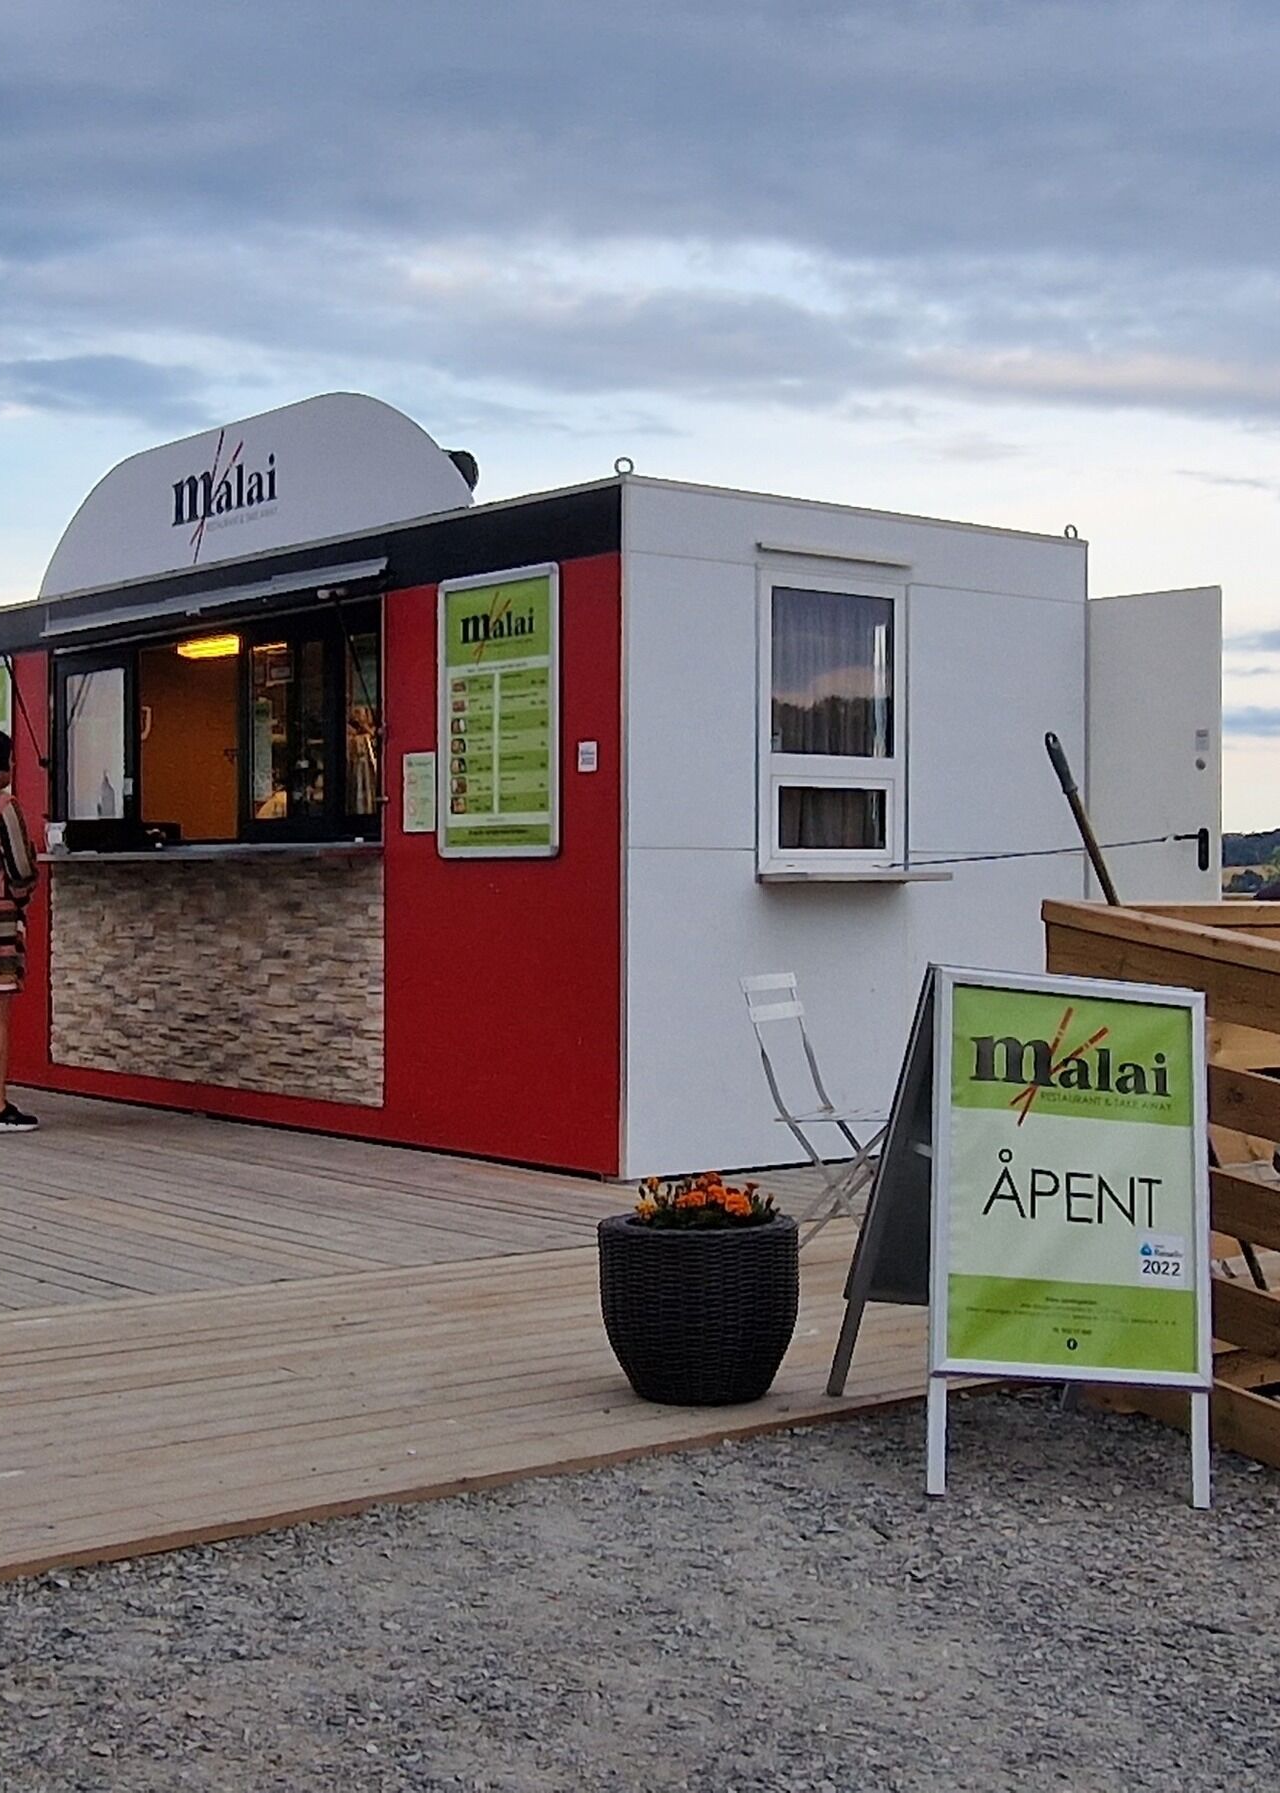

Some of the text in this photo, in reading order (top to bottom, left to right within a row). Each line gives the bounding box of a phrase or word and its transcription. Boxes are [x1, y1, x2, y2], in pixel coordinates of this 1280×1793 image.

[1040, 1091, 1101, 1106] RESTAURANT
[982, 1148, 1163, 1228] ÅPENT
[1142, 1259, 1181, 1277] 2022
